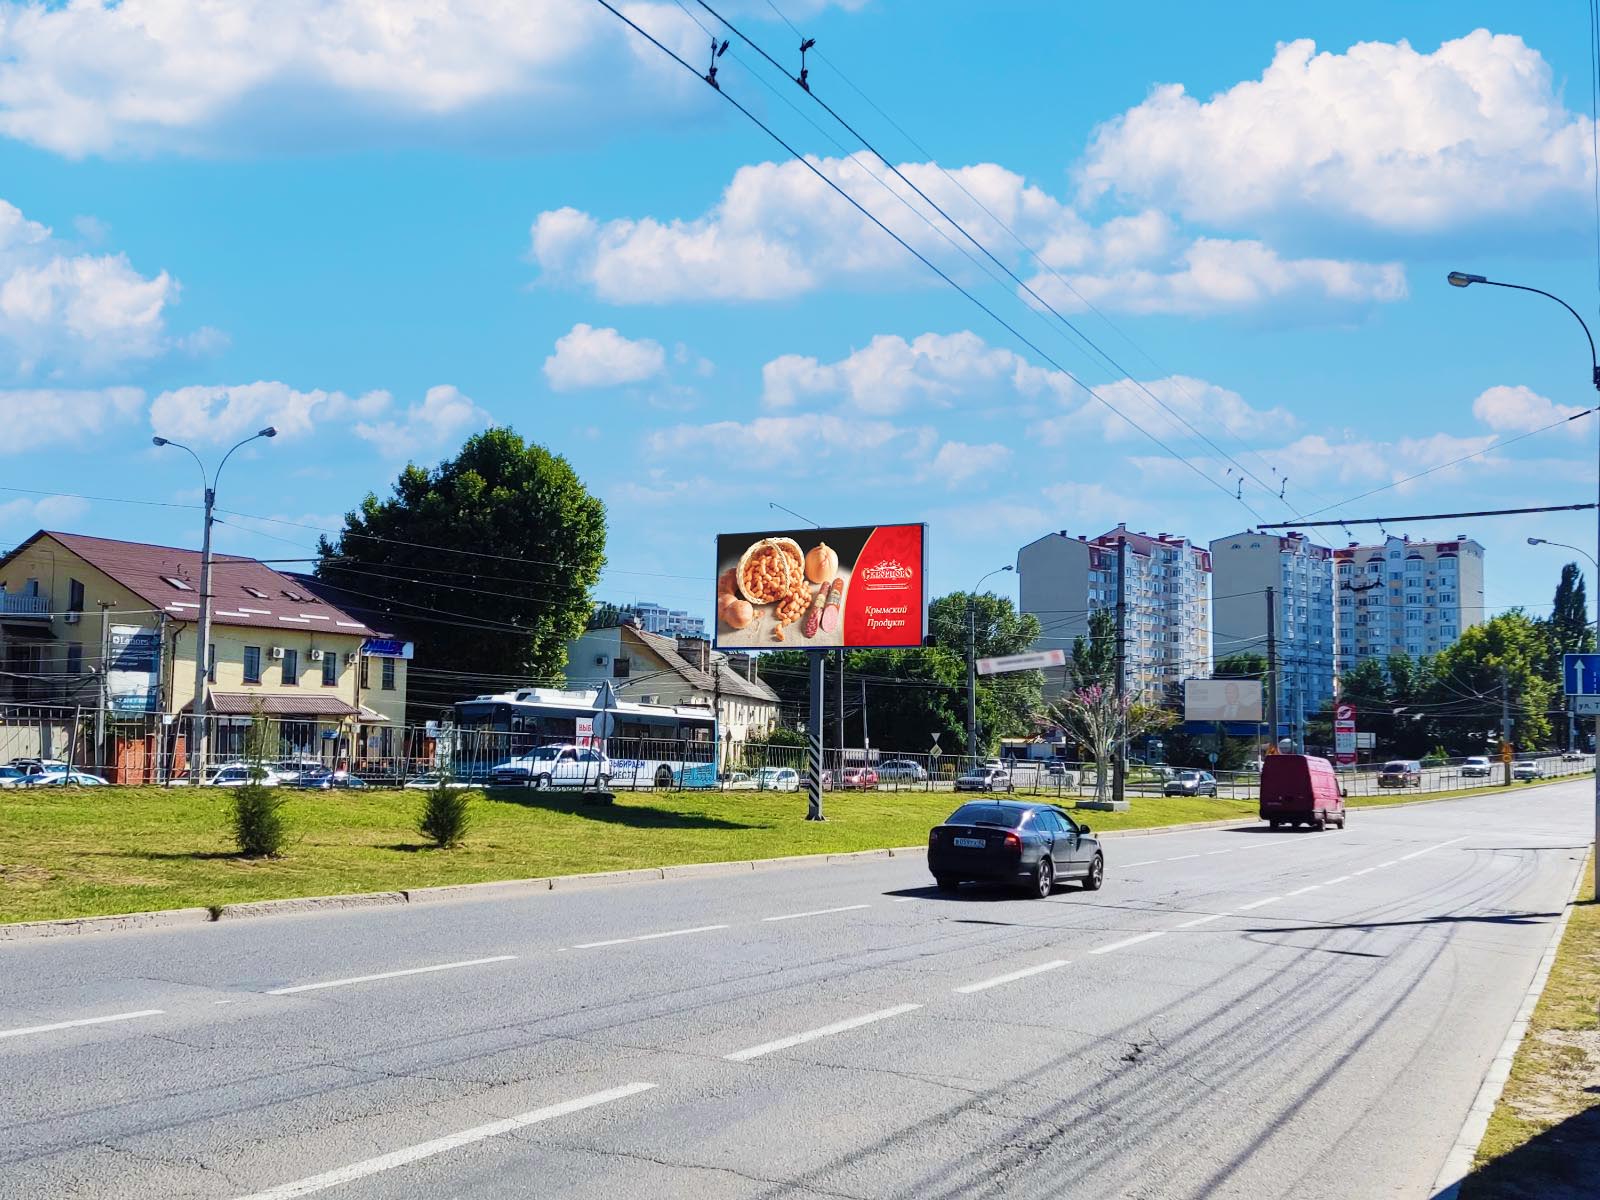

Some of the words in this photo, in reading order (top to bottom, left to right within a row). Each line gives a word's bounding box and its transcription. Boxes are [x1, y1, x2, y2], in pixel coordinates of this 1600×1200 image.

[865, 605, 908, 617] Крымский
[867, 618, 905, 629] Продукт
[578, 723, 592, 732] ВЫБ
